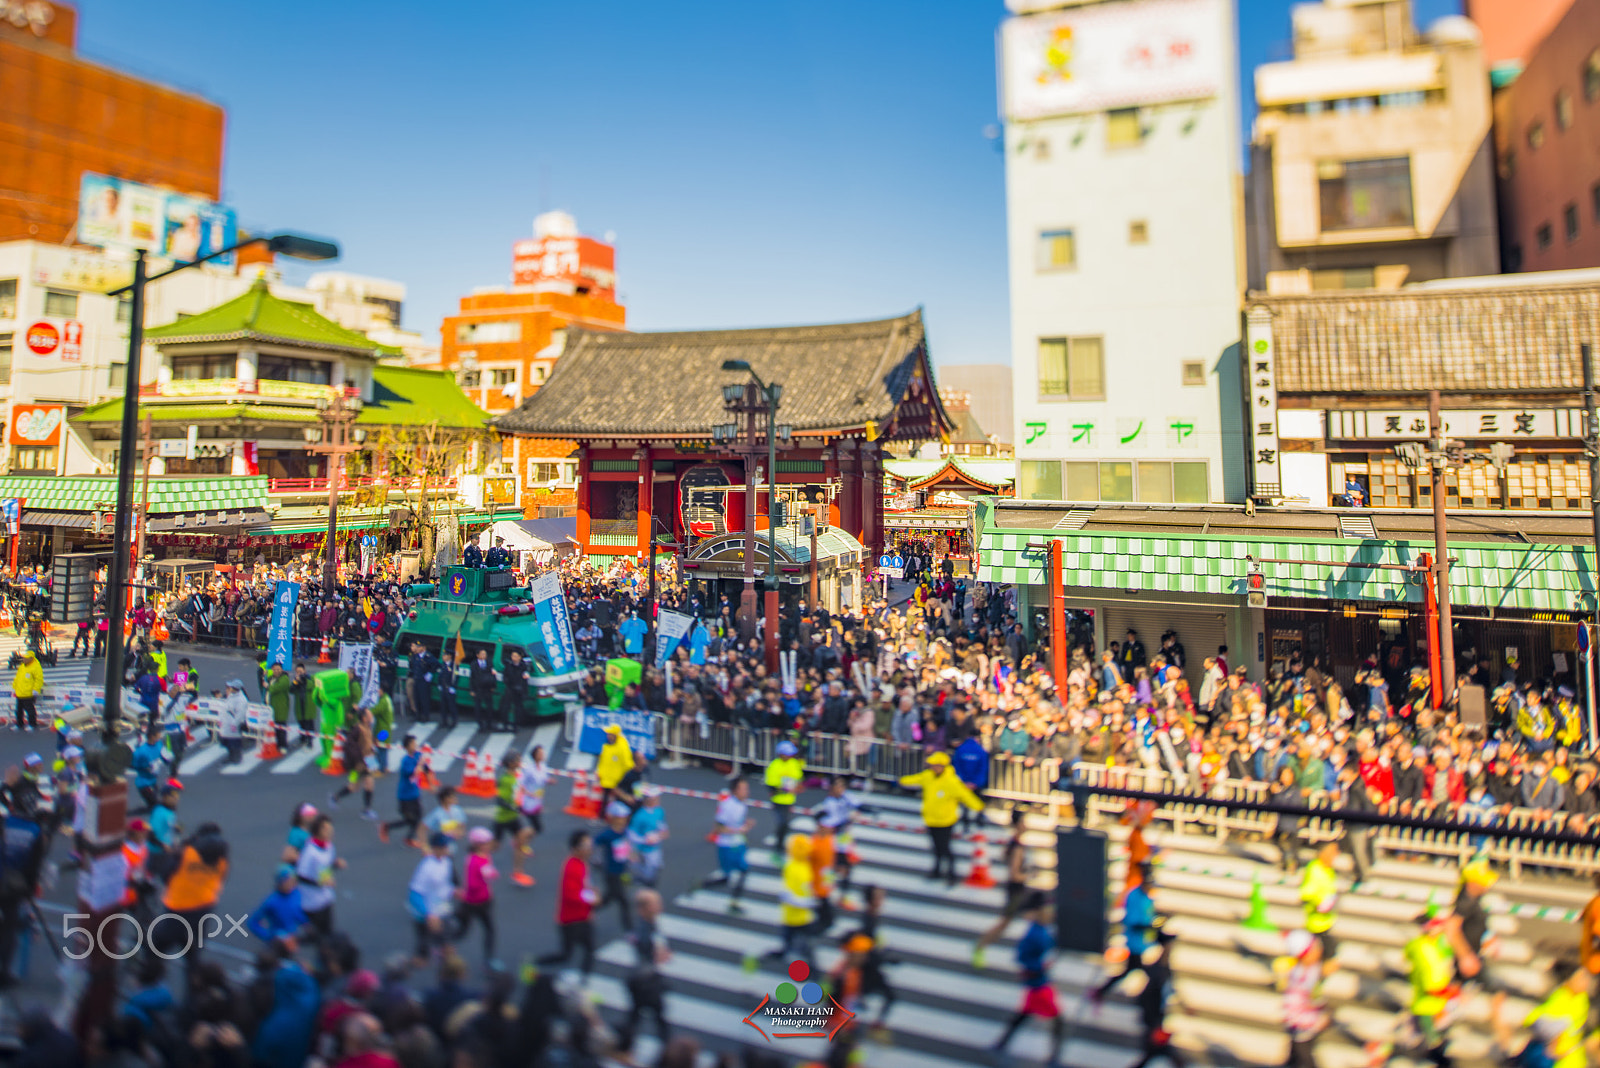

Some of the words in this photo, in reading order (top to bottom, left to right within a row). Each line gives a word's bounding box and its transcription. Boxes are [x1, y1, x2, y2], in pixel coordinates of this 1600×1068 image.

[1025, 420, 1194, 445] アオノヤ
[1479, 411, 1535, 434] 三定
[1257, 423, 1275, 464] 三定
